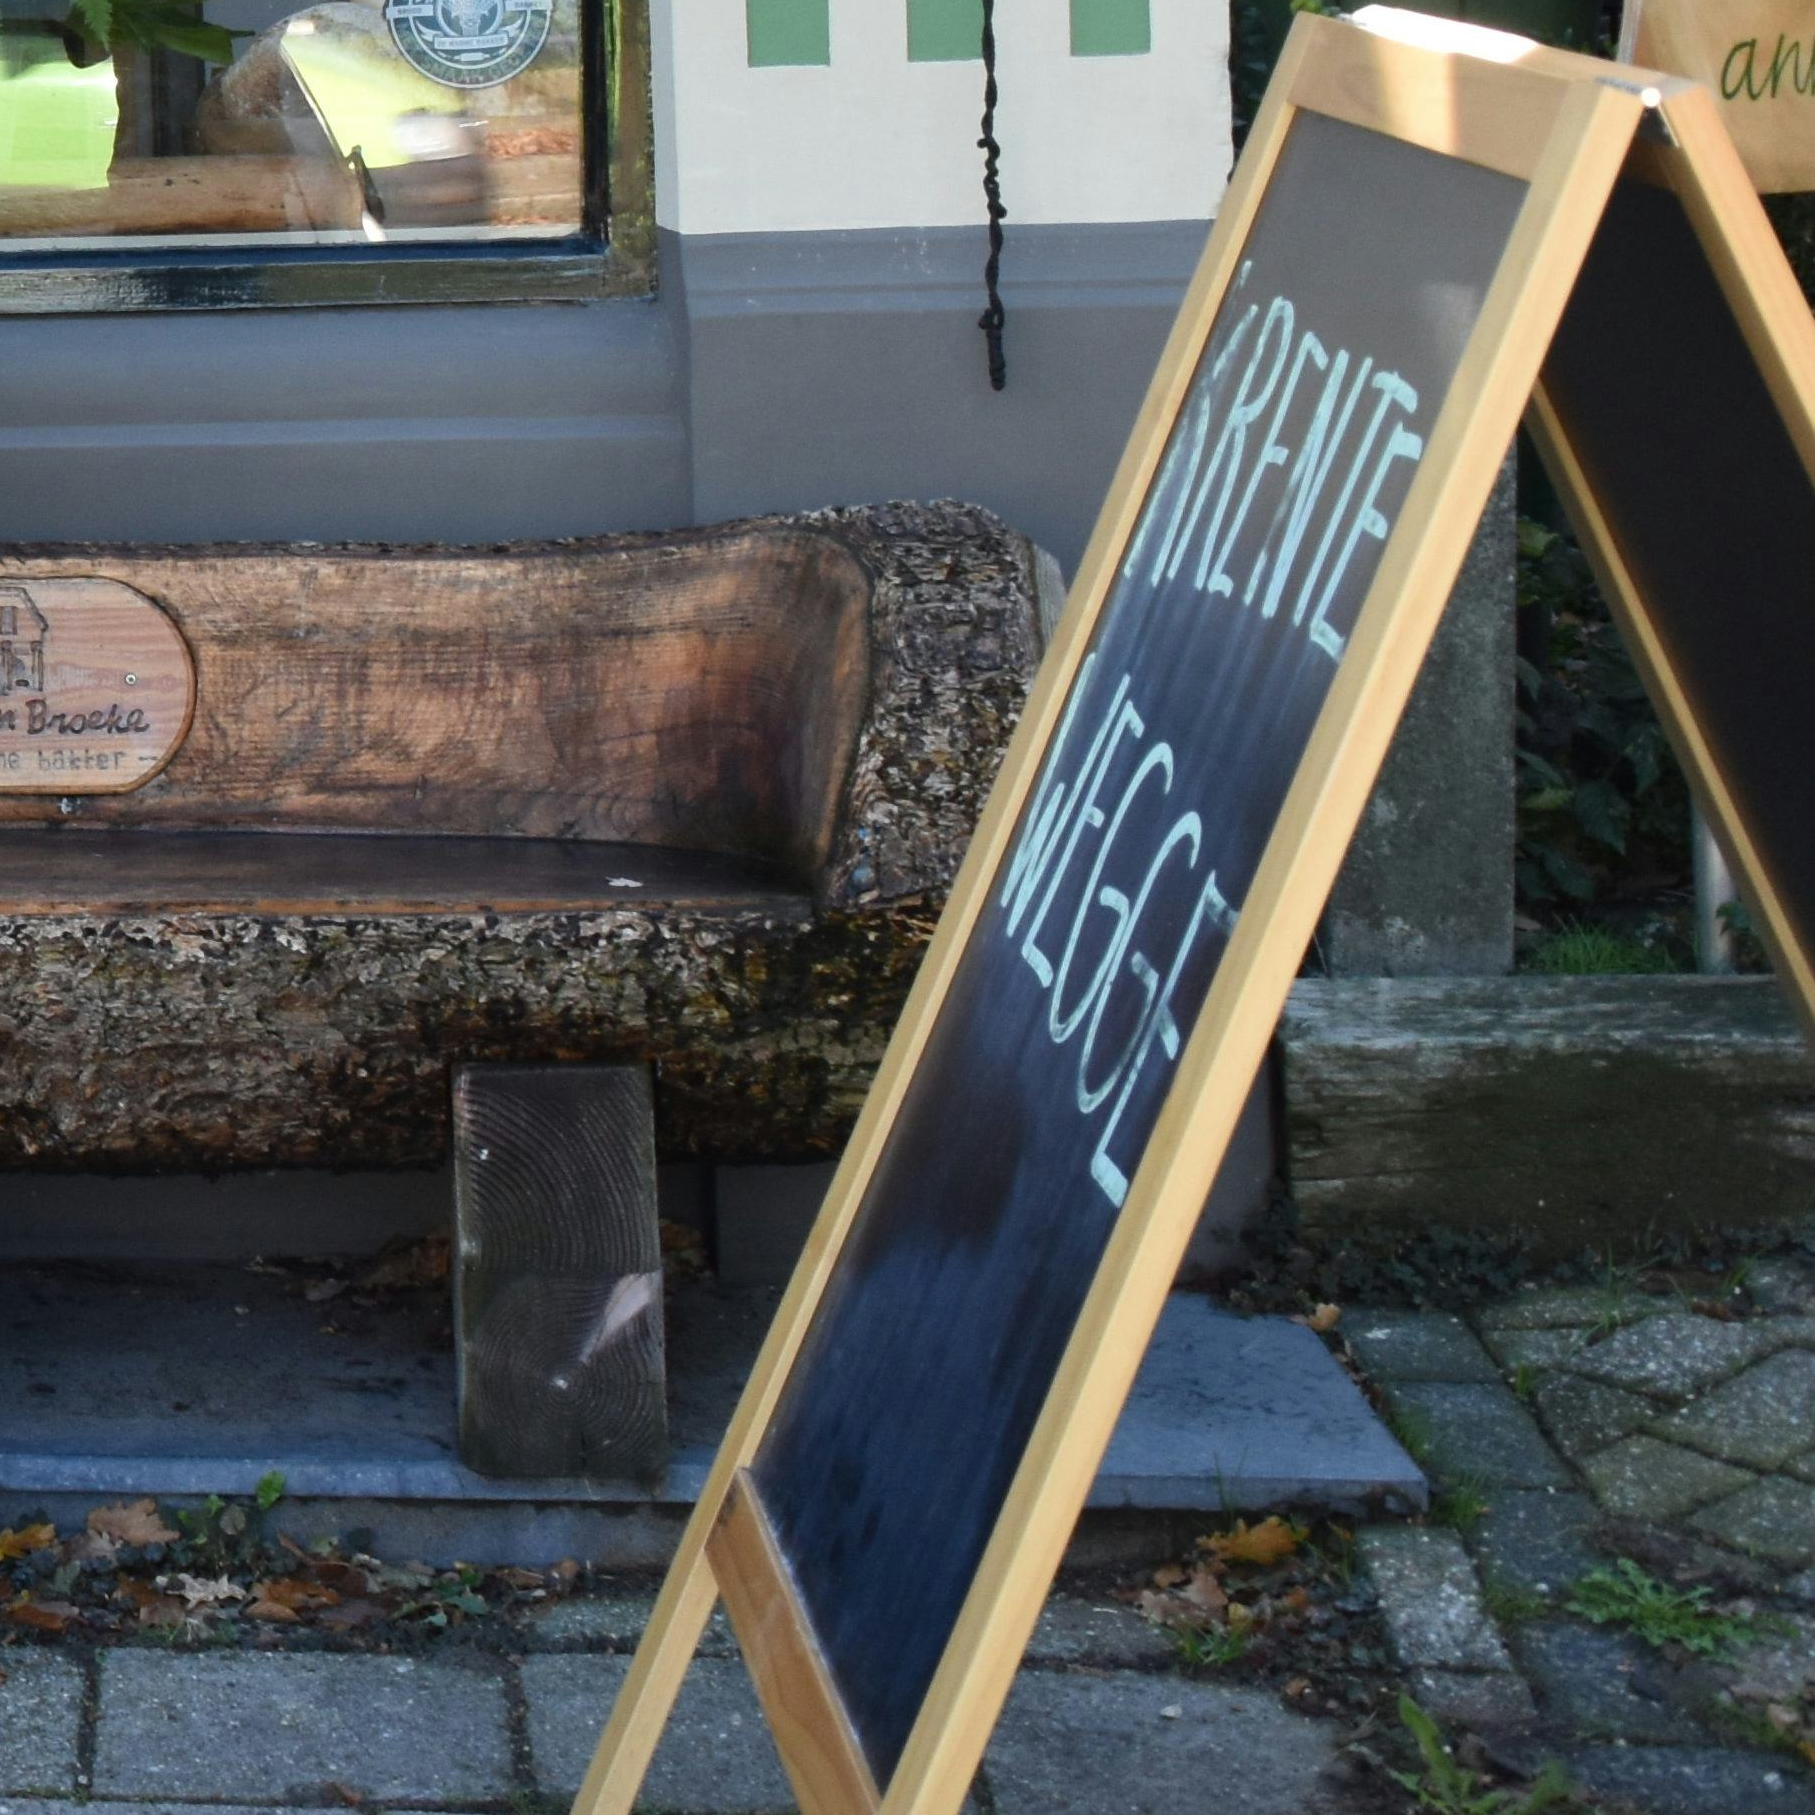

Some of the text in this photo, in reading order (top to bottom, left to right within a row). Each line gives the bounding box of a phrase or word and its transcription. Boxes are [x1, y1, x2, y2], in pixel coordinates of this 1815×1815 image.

[1721, 33, 1815, 101] an
[25, 698, 150, 735] Broeke
[37, 749, 124, 771] bakker
